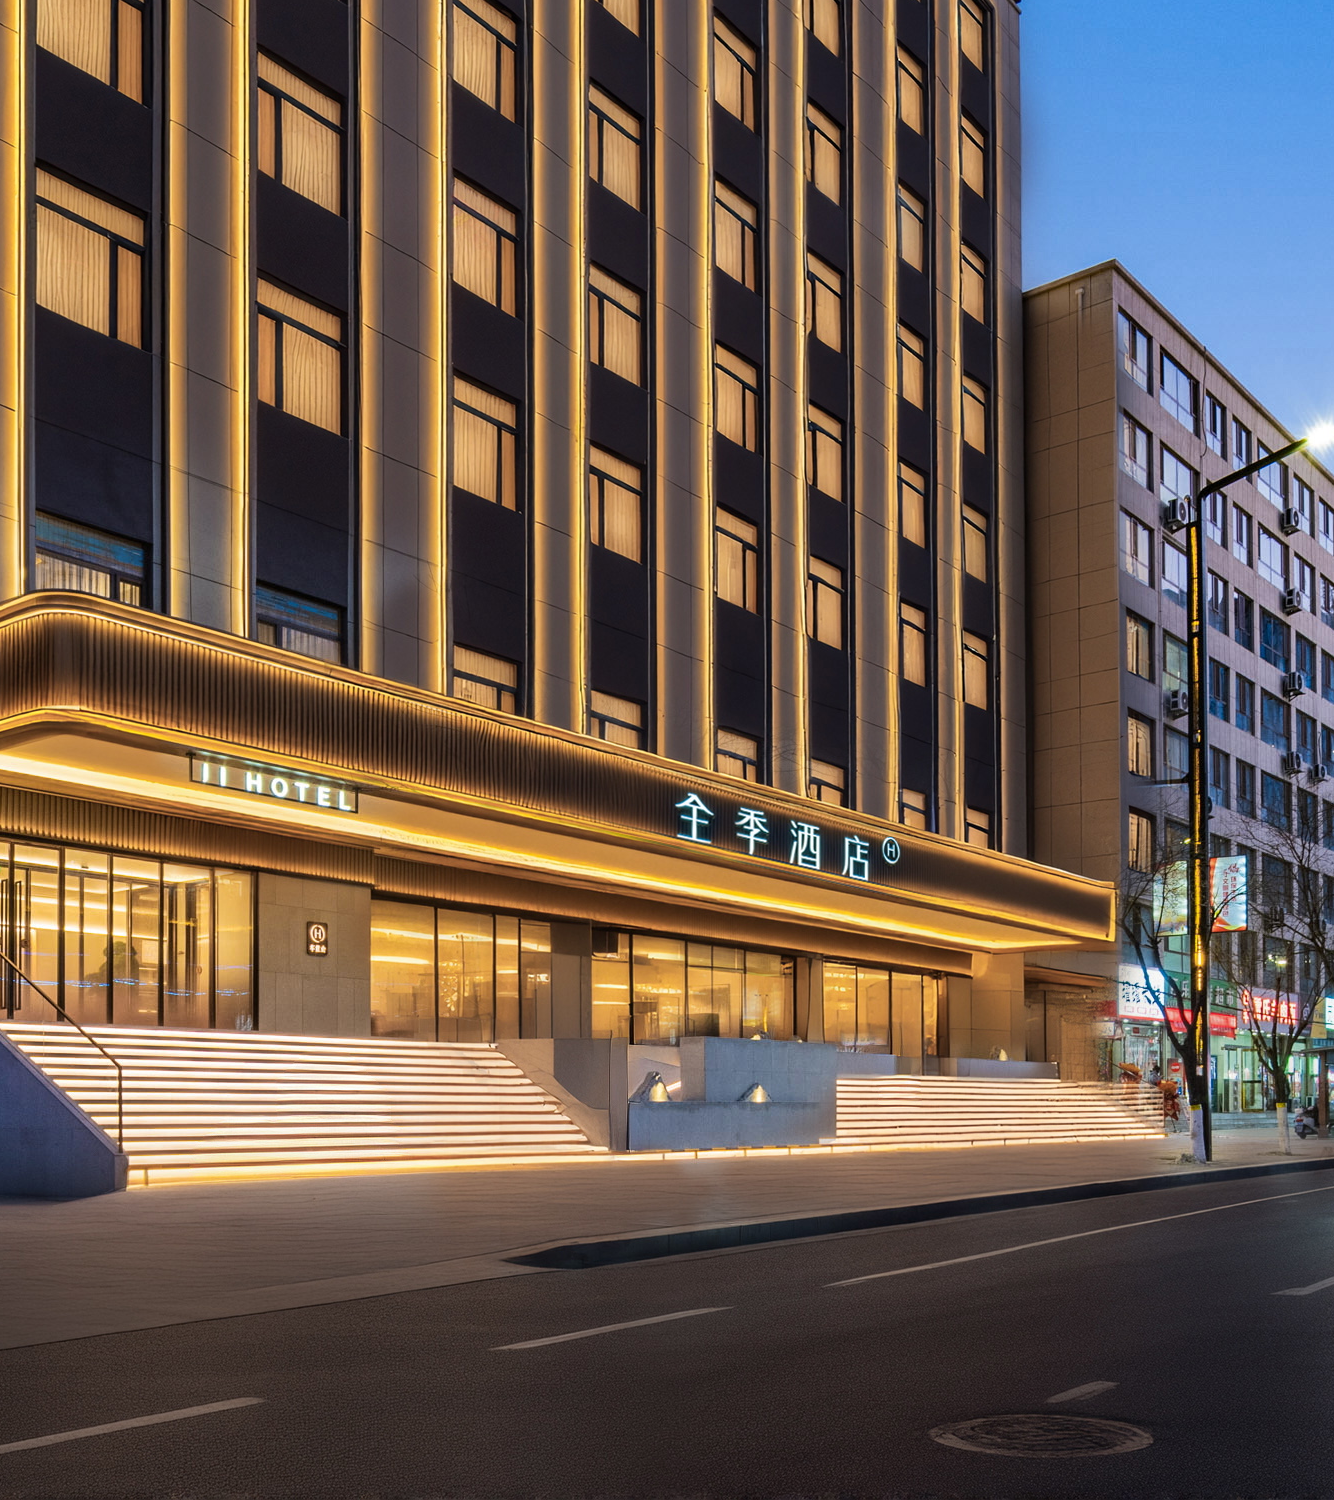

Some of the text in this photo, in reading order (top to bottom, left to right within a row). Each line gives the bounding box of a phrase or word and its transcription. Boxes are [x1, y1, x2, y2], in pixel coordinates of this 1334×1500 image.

[244, 770, 352, 812] HOTEL
[675, 792, 870, 881] 全季酒店
